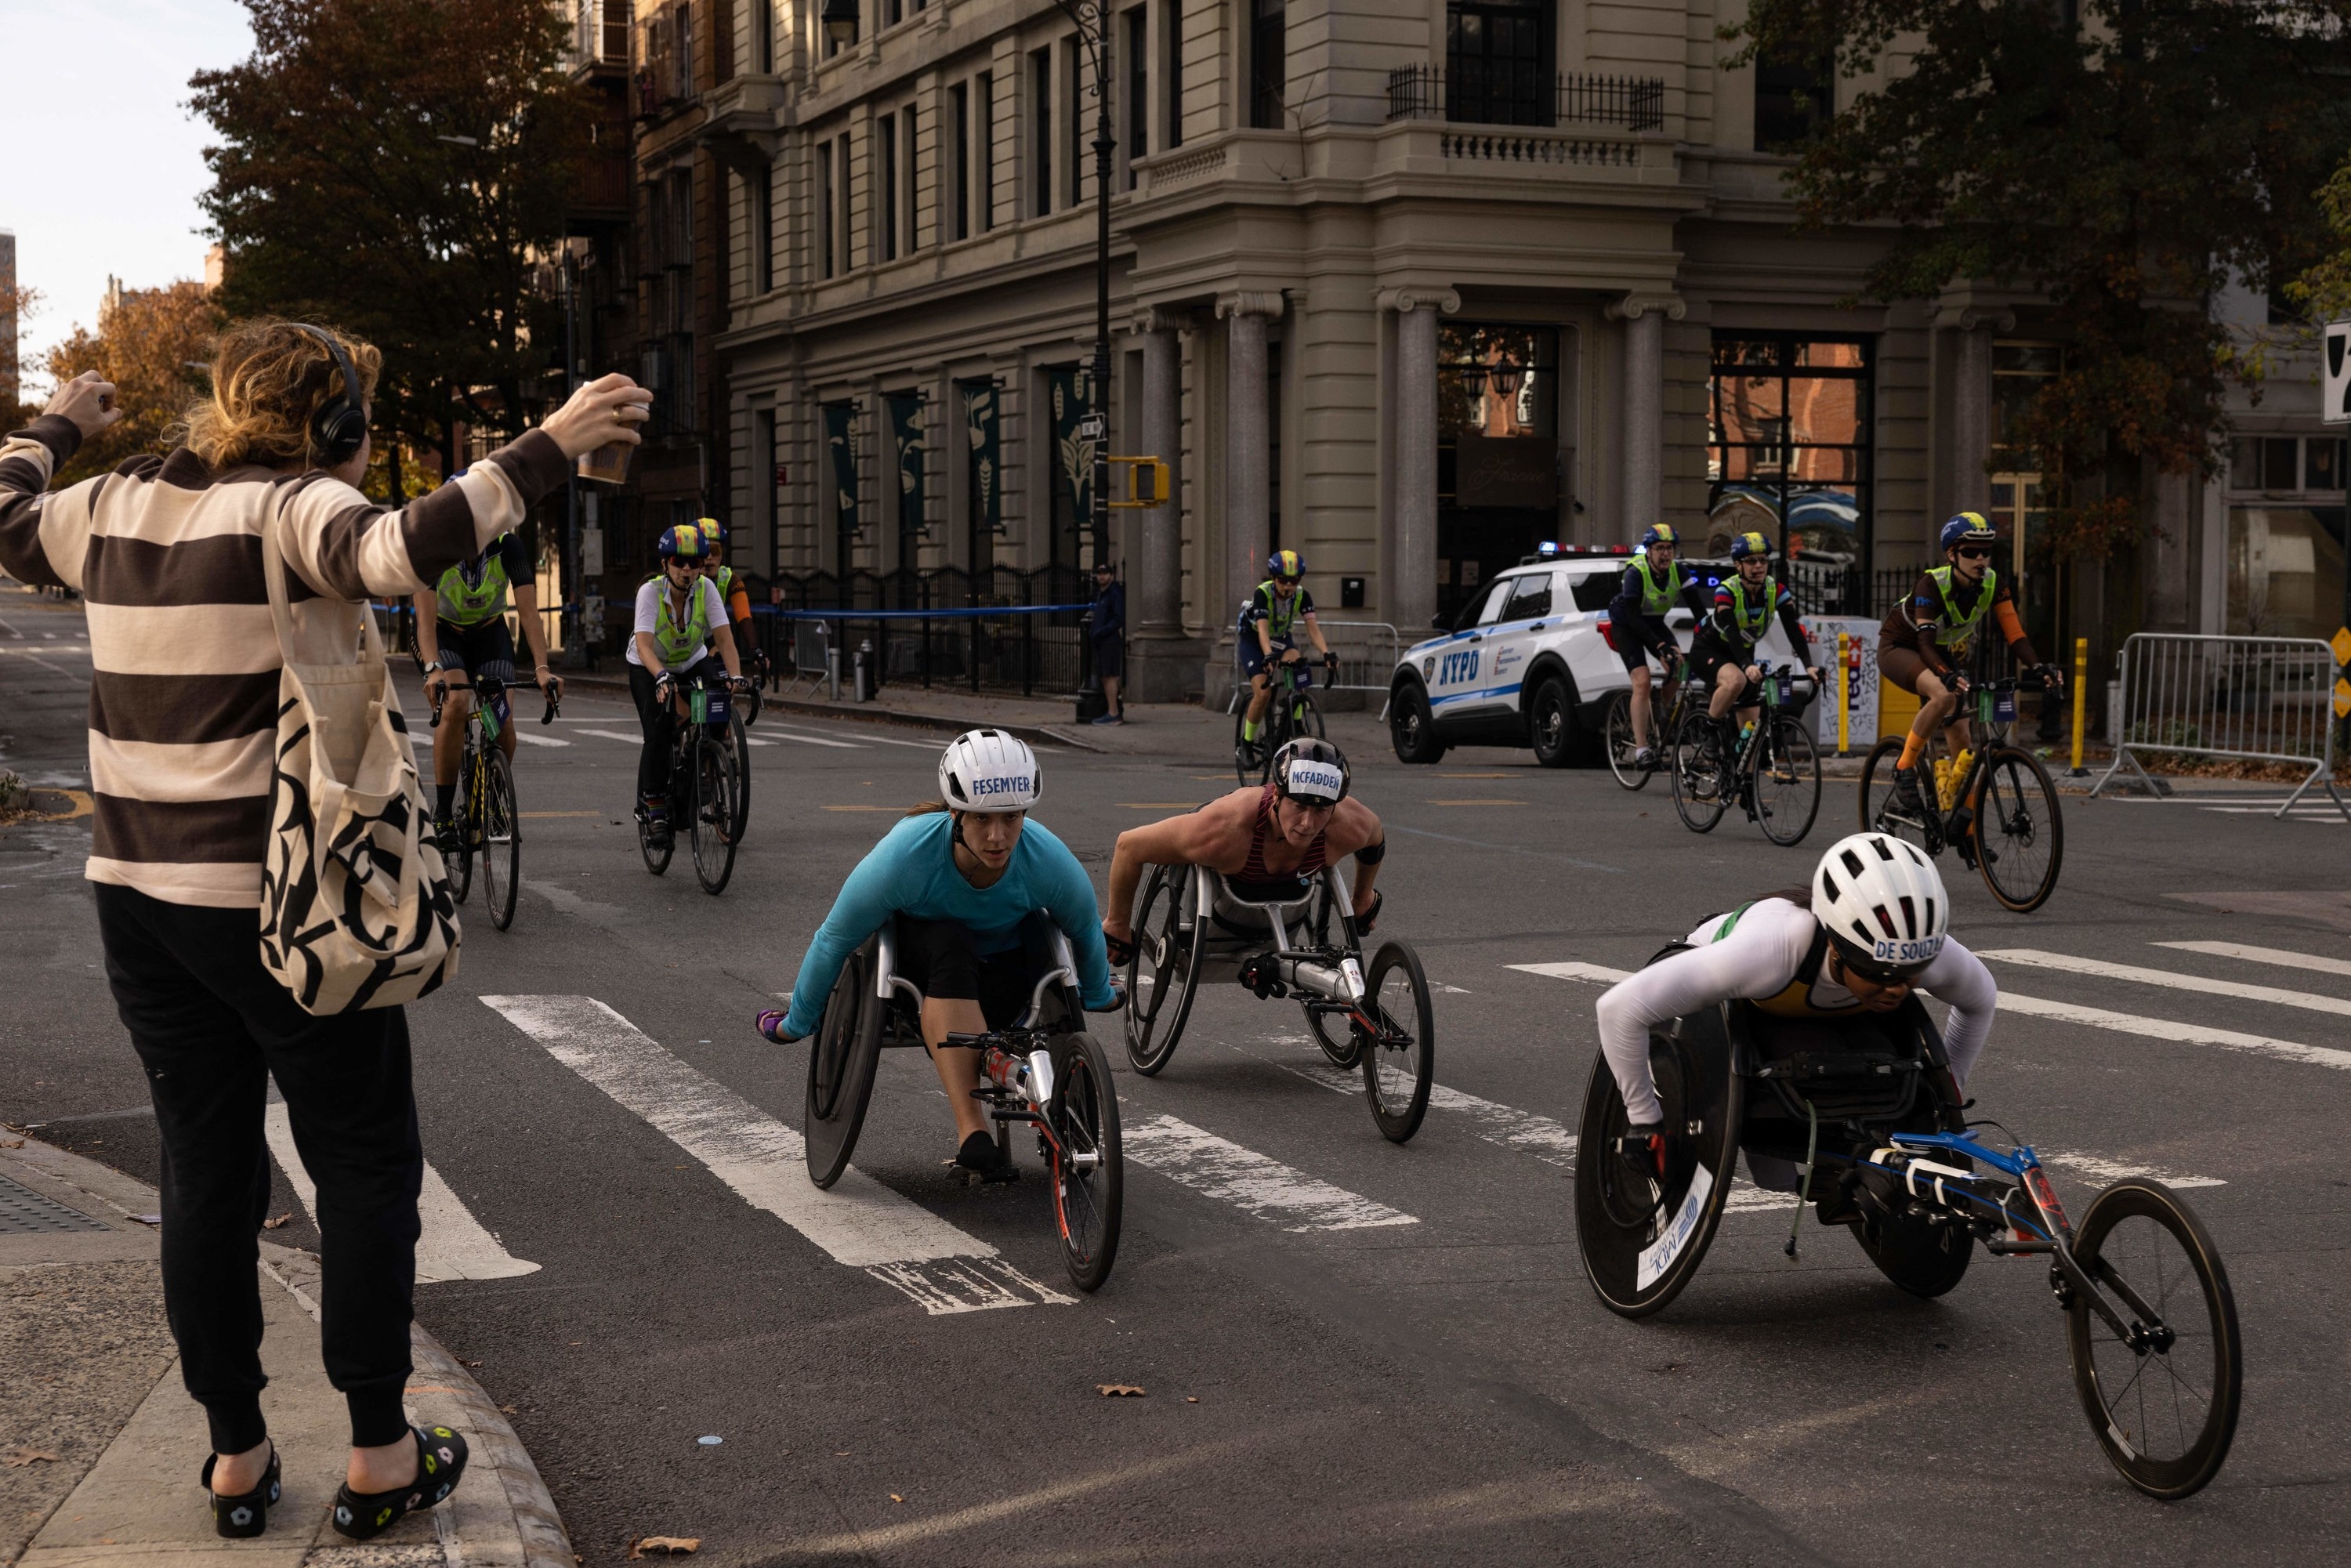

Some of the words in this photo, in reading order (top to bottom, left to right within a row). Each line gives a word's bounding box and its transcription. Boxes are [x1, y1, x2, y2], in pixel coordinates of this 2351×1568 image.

[1440, 650, 1480, 686] NYPD
[973, 777, 1031, 795] FESEMYER
[1292, 771, 1339, 791] MCFADDEN
[1876, 940, 1896, 960] DE
